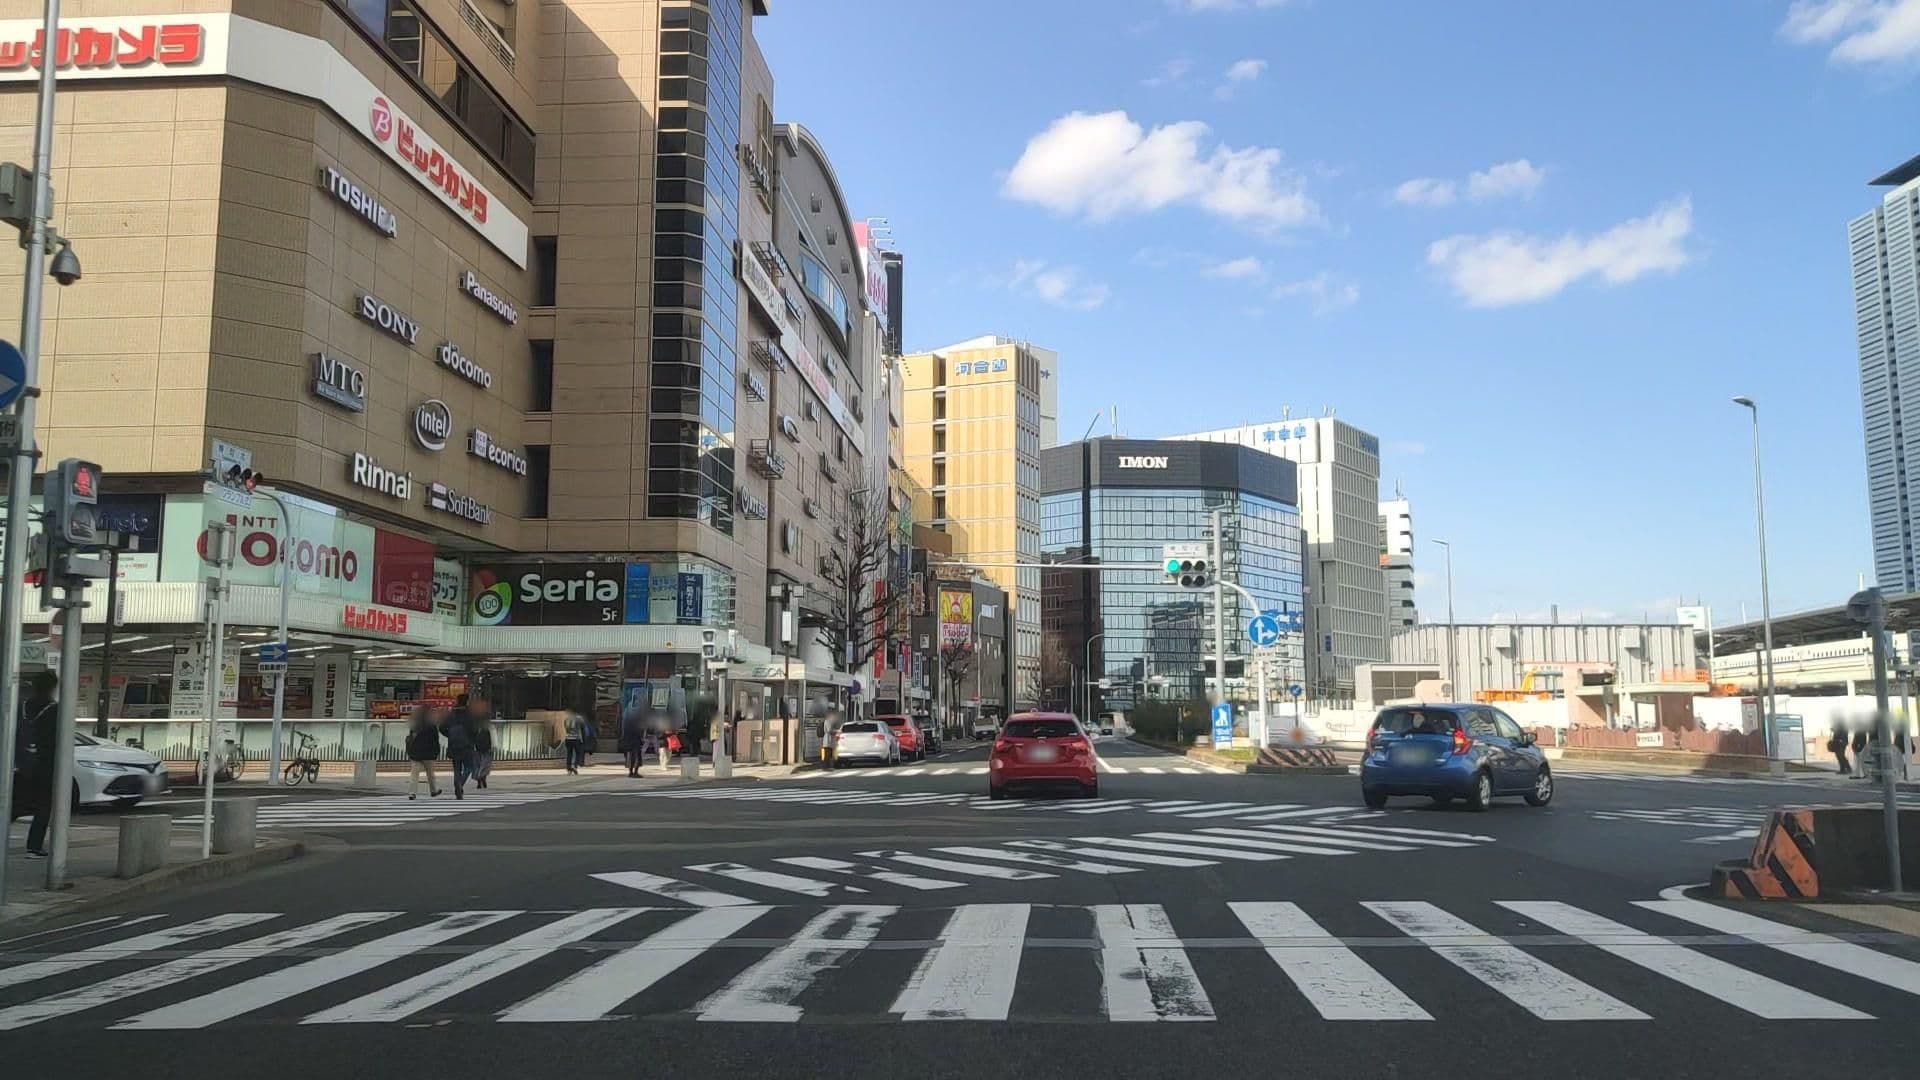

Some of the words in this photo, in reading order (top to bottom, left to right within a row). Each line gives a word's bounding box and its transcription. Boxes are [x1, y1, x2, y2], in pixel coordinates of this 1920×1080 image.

[397, 118, 488, 225] ビックカメラ
[466, 271, 518, 325] Panasonic
[363, 295, 420, 344] SONY
[320, 352, 364, 398] MTG
[442, 341, 492, 389] docomo
[421, 404, 447, 437] intel
[354, 452, 412, 500] Rinnai
[1118, 456, 1169, 469] IMON
[242, 515, 278, 529] NTT
[447, 489, 492, 525] SoftBank
[520, 570, 619, 603] Seria
[344, 605, 408, 634] ビックカメラ
[480, 597, 499, 612] 100
[602, 607, 618, 622] 5F
